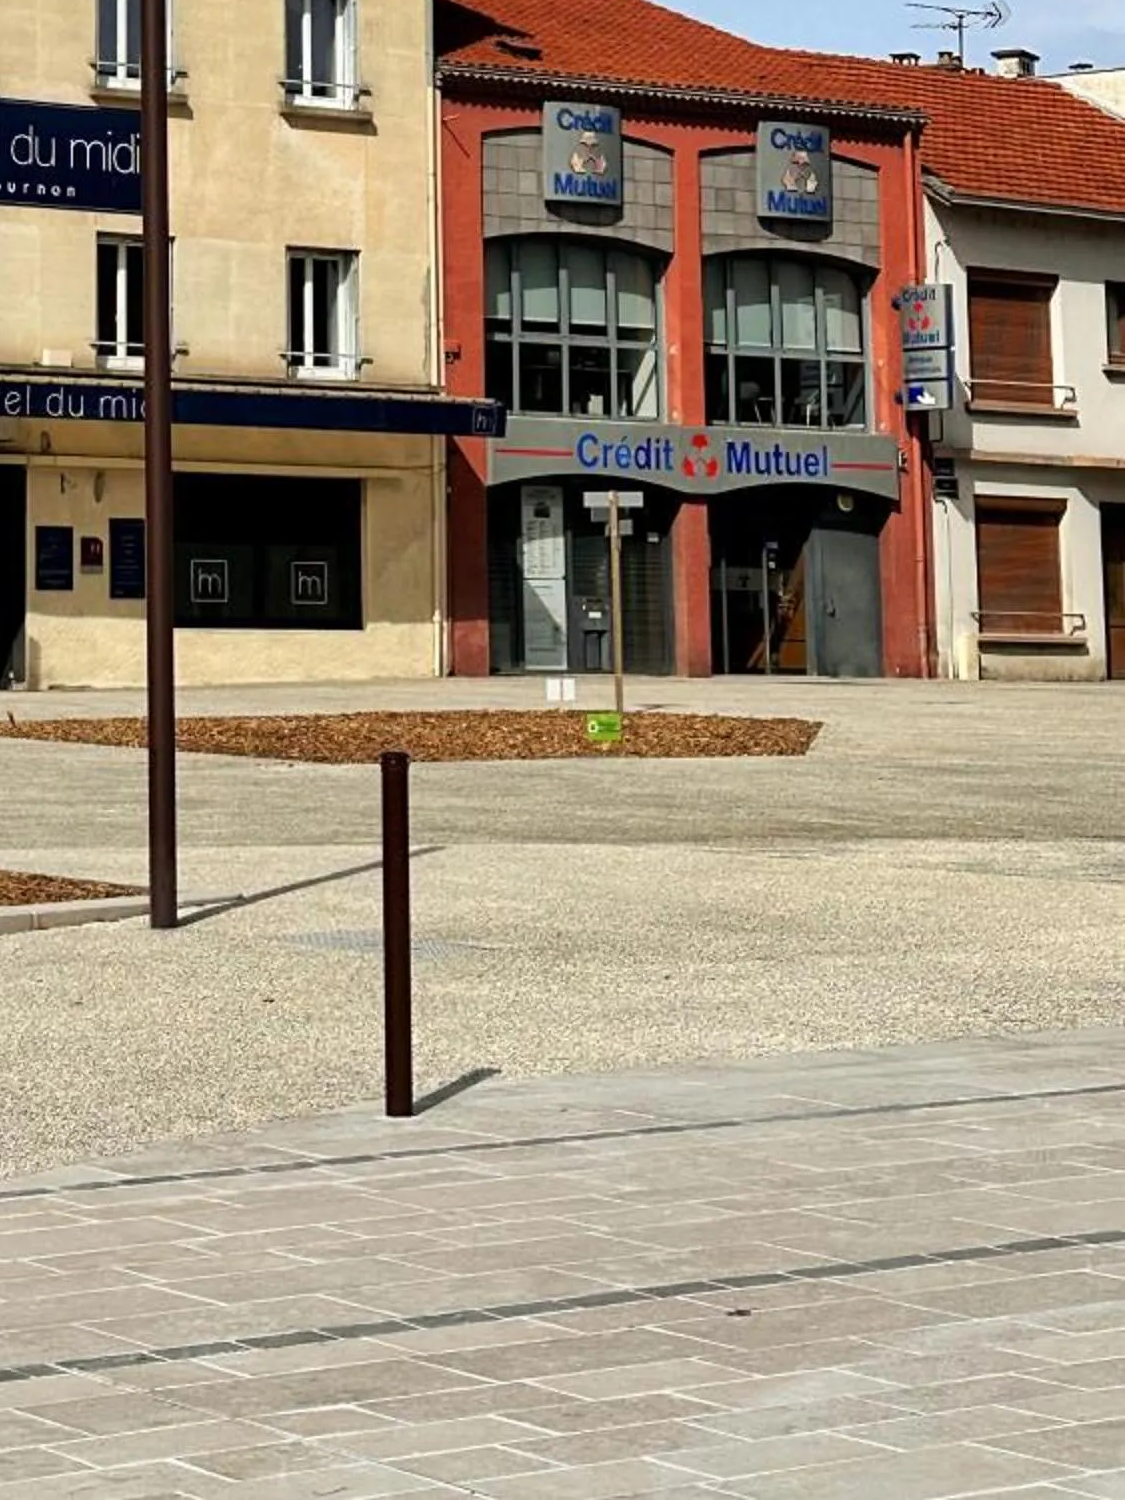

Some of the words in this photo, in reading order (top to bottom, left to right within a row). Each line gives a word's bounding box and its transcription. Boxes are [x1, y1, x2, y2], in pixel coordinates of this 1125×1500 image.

[556, 107, 613, 134] Crédit
[10, 125, 57, 167] du
[70, 130, 141, 175] midi
[770, 127, 822, 150] Crédit
[553, 172, 616, 198] Mutuel
[767, 190, 825, 215] Mutuel
[46, 386, 85, 418] du
[99, 387, 146, 419] mi
[577, 433, 674, 472] Crédit
[726, 440, 829, 477] Mutuel
